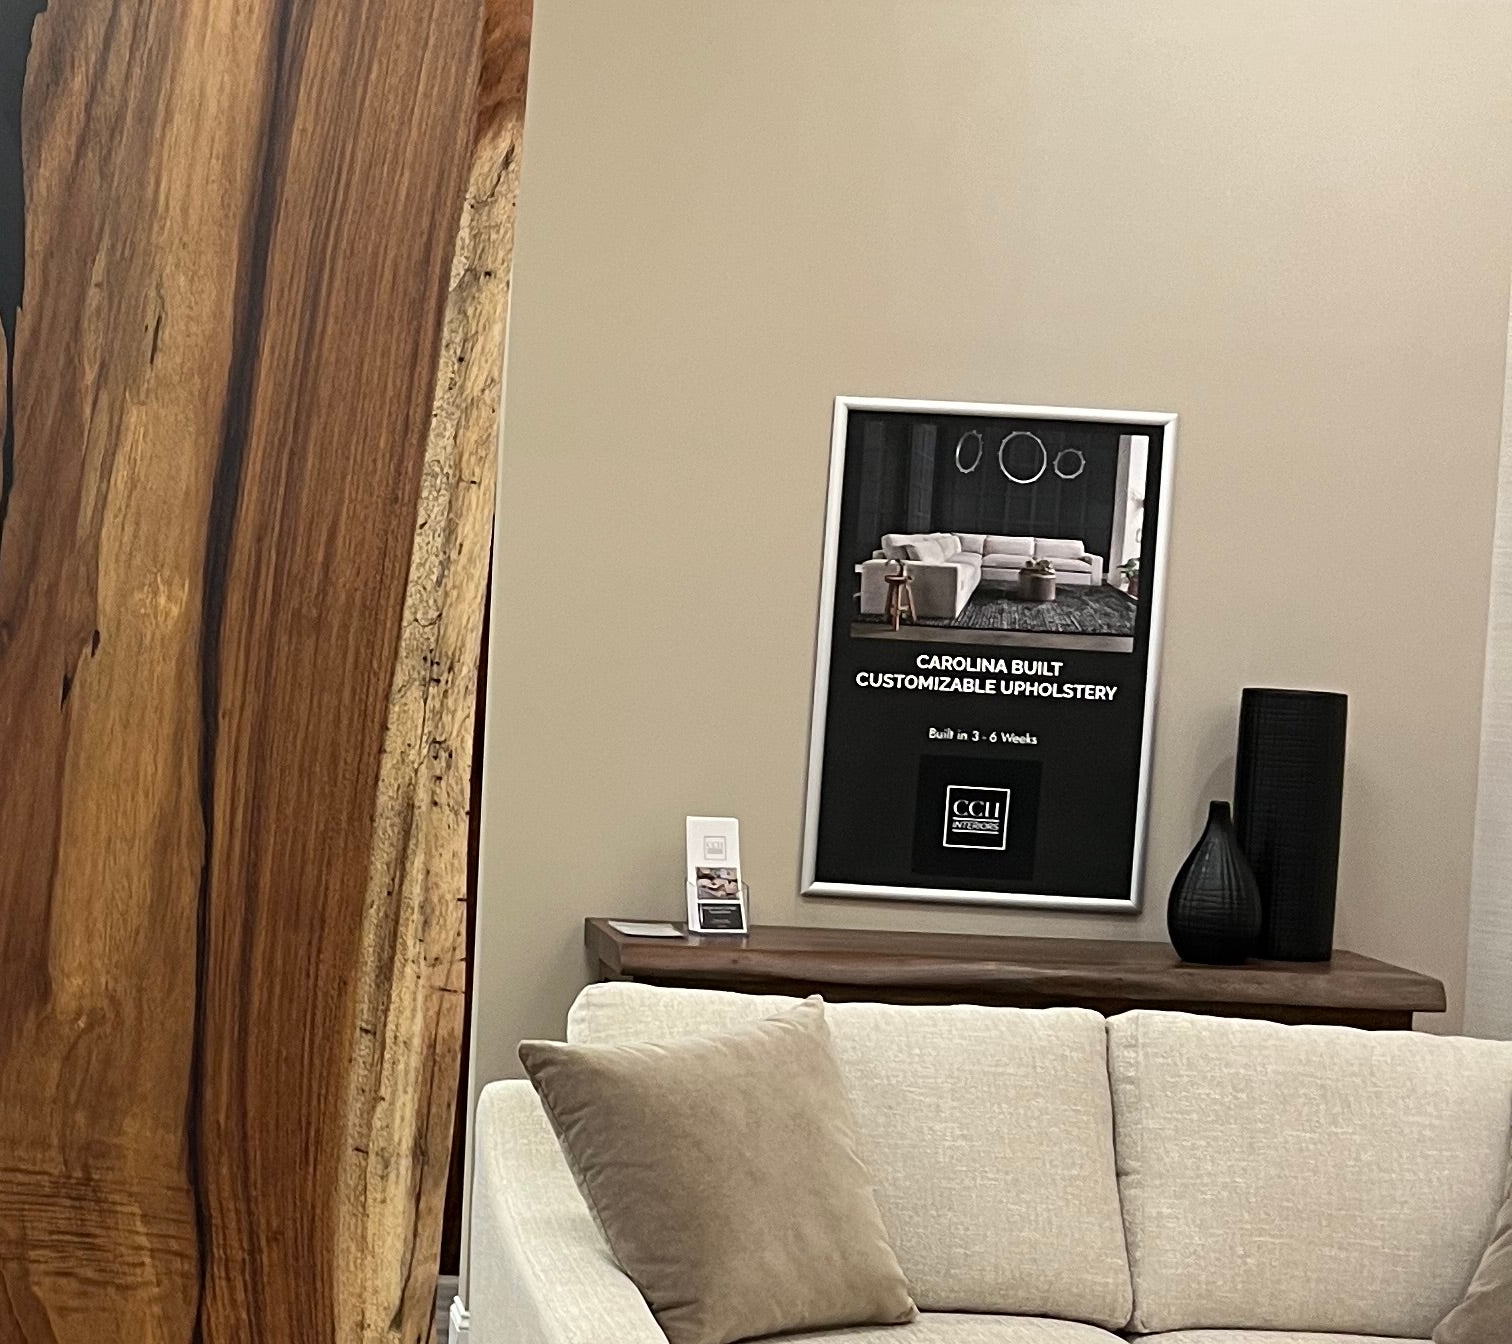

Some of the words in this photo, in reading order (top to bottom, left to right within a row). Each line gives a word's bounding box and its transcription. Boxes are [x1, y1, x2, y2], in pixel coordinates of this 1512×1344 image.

[916, 654, 1008, 674] CAROLINA
[1011, 659, 1064, 677] BUILT
[855, 671, 997, 695] CUSTOMIZABLE
[1000, 679, 1118, 701] UPHOLSTERY
[929, 727, 954, 740] Built
[957, 728, 968, 740] in
[971, 730, 980, 742] 3
[989, 731, 998, 743] 6
[1001, 731, 1038, 745] Weeks
